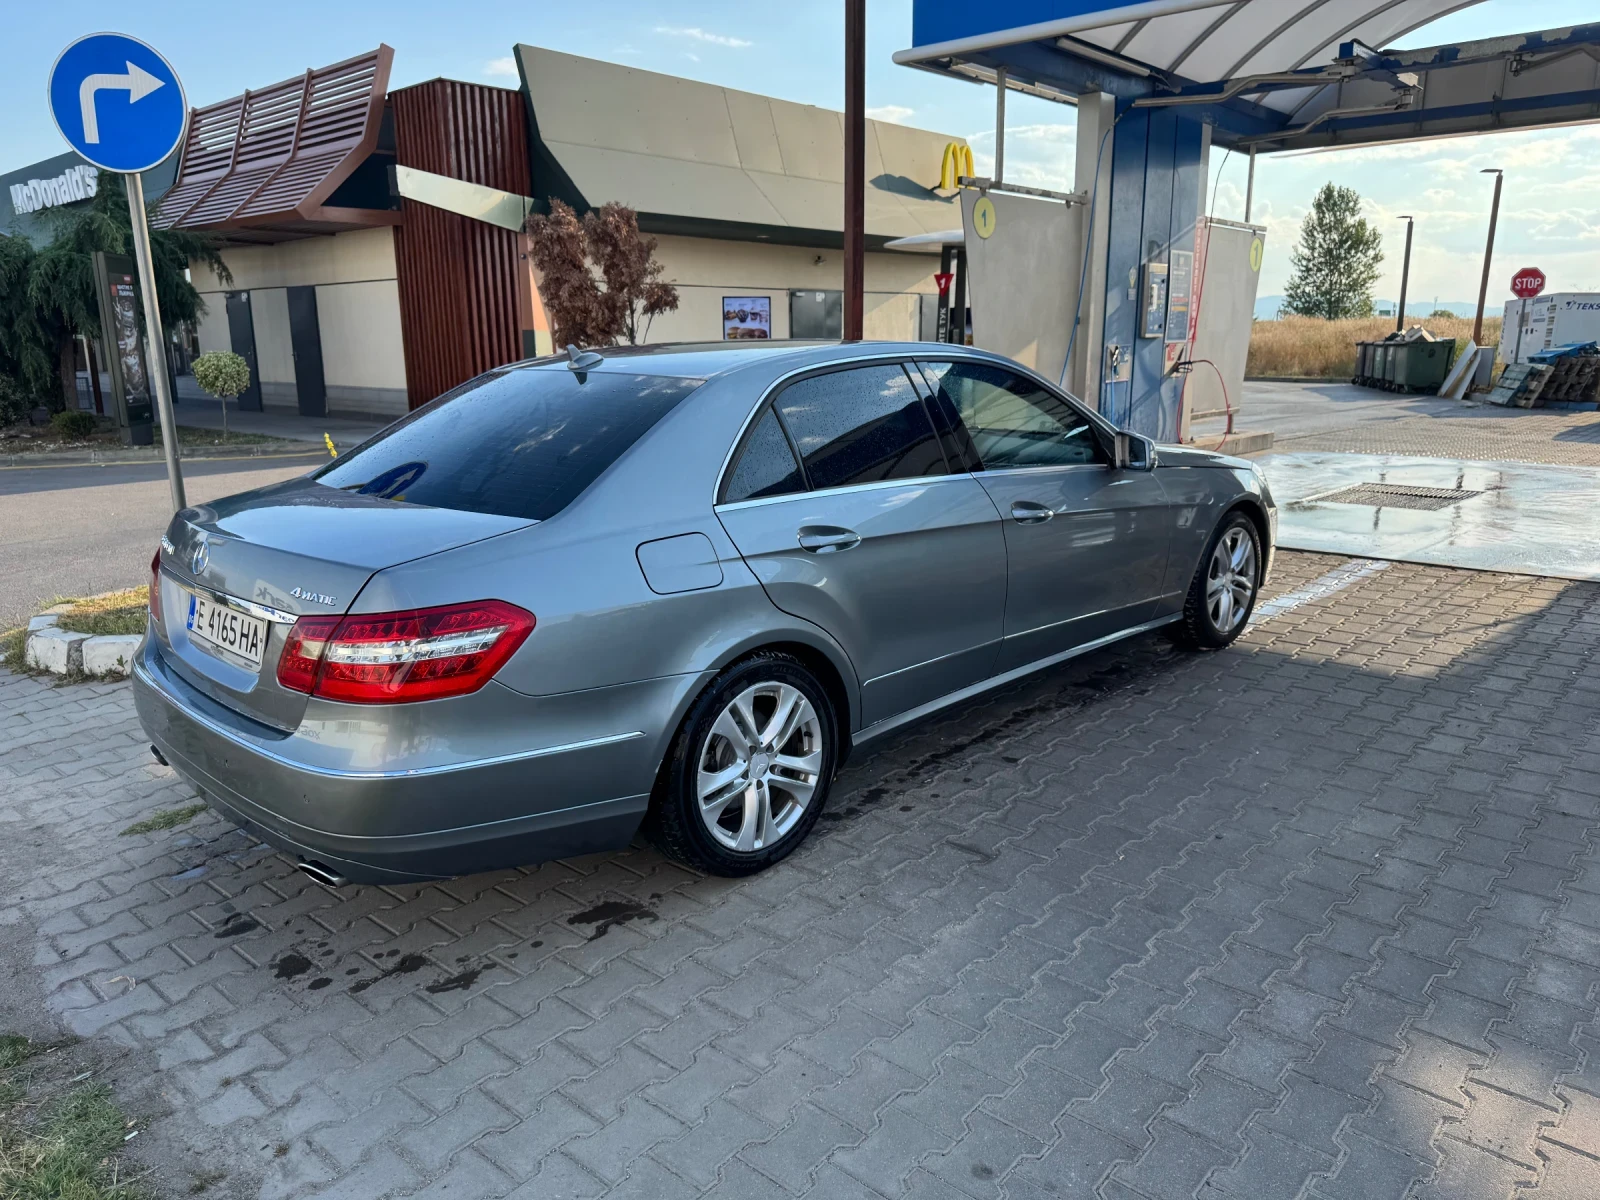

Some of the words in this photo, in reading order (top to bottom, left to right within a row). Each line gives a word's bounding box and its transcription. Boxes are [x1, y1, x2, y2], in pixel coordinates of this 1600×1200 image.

[10, 165, 98, 215] McDonald's
[981, 209, 987, 228] 1
[940, 278, 946, 289] 1
[1515, 278, 1541, 289] STOP
[290, 586, 338, 606] 4MATIC
[197, 600, 206, 631] E
[208, 607, 238, 646] 4165
[239, 619, 259, 657] HA
